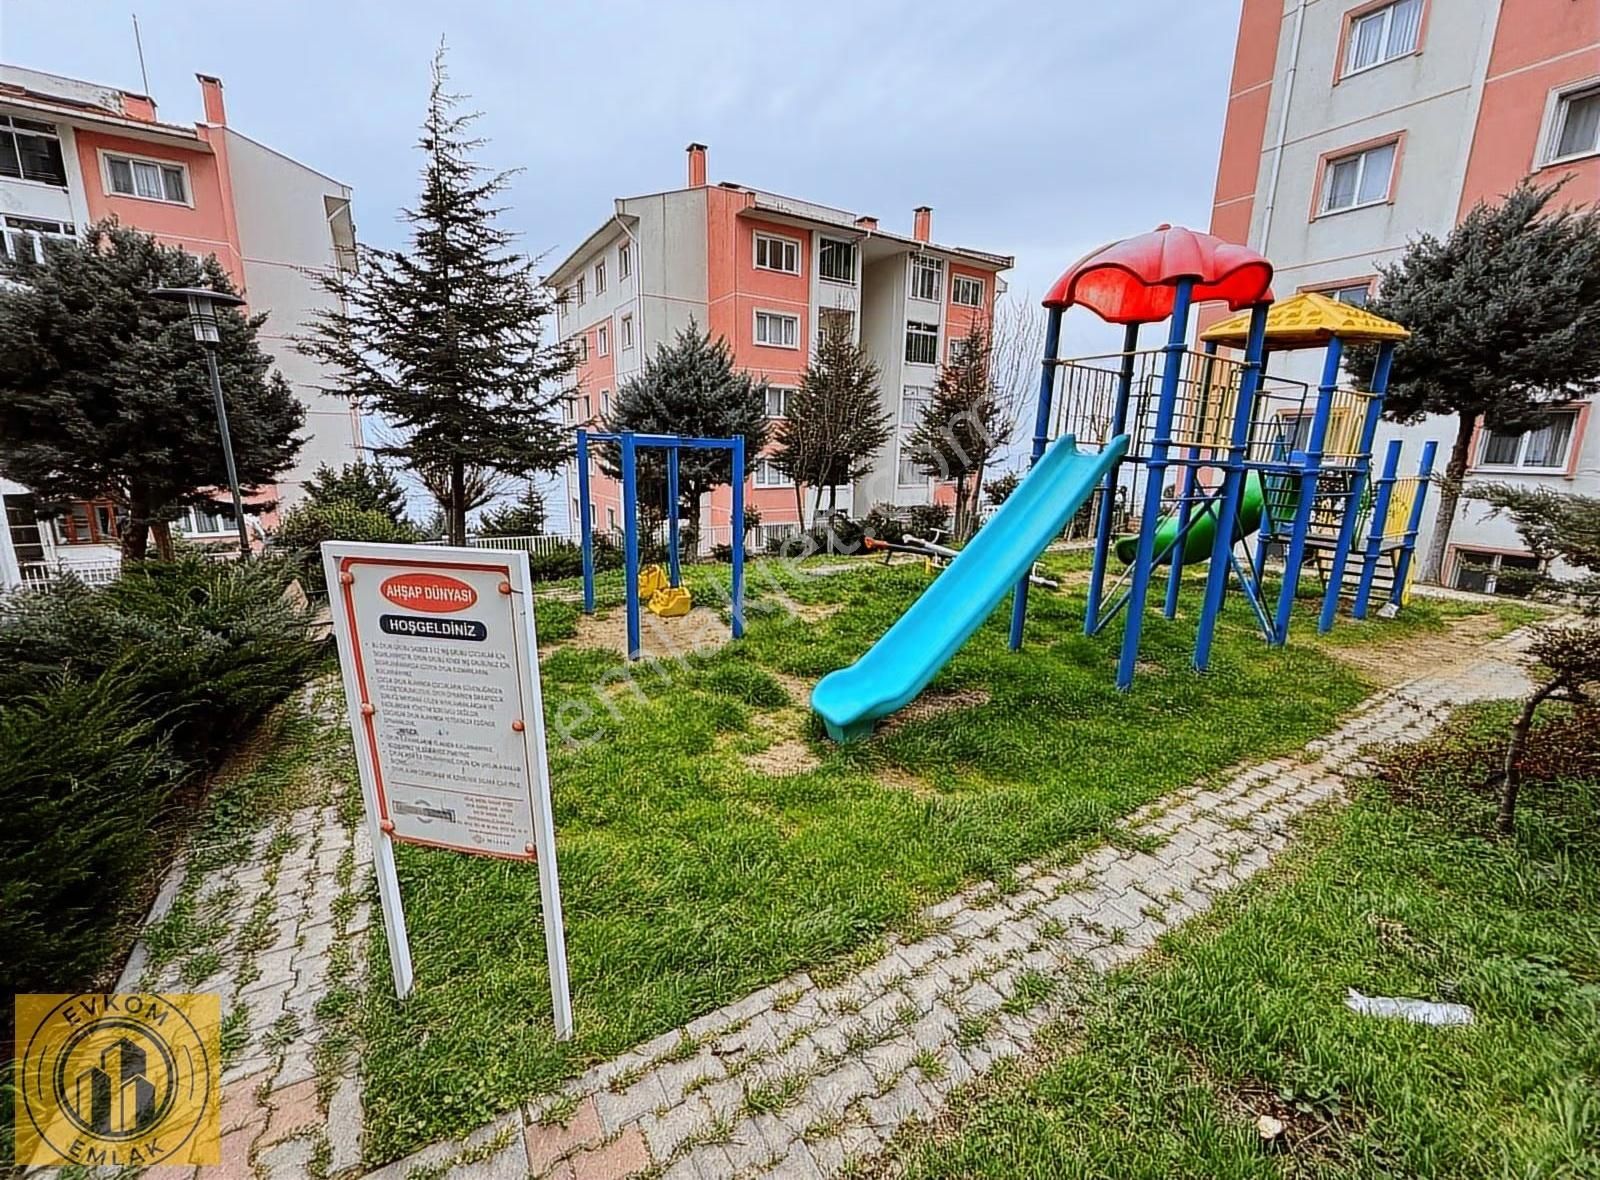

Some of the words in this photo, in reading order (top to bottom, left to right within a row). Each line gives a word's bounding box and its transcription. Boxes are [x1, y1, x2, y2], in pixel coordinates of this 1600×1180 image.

[387, 584, 423, 601] AHŞAP
[424, 585, 473, 605] DÜNYASI
[389, 618, 477, 637] HOŞGELDİNİZ
